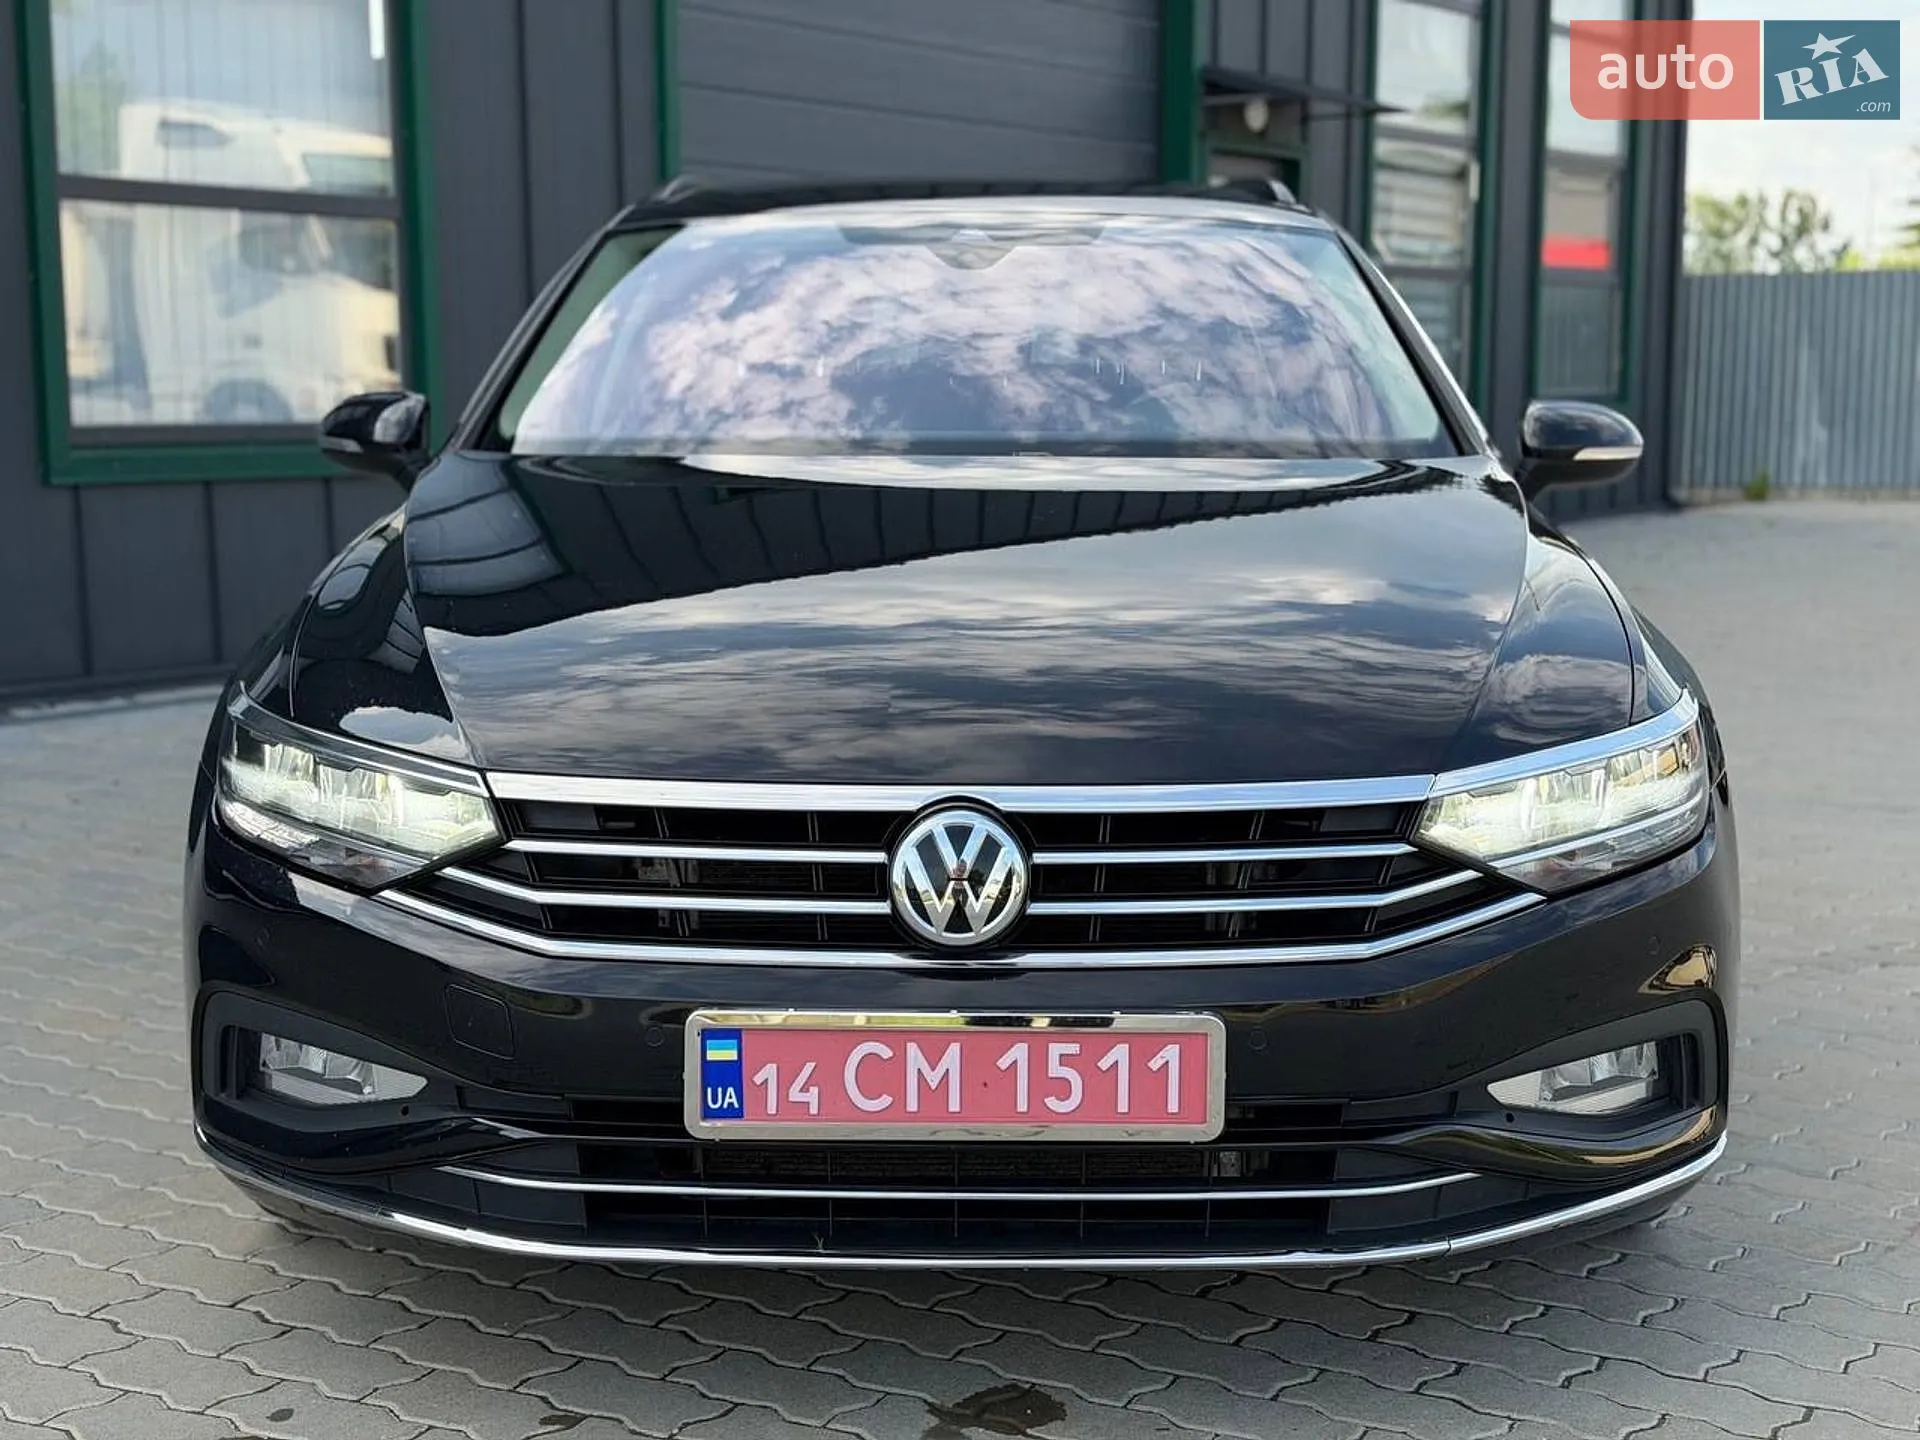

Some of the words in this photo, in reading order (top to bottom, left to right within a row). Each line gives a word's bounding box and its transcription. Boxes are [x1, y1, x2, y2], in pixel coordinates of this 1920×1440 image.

[706, 1086, 738, 1109] UA
[752, 1061, 819, 1115] 14
[843, 1041, 961, 1113] CM
[995, 1042, 1181, 1114] 1511
